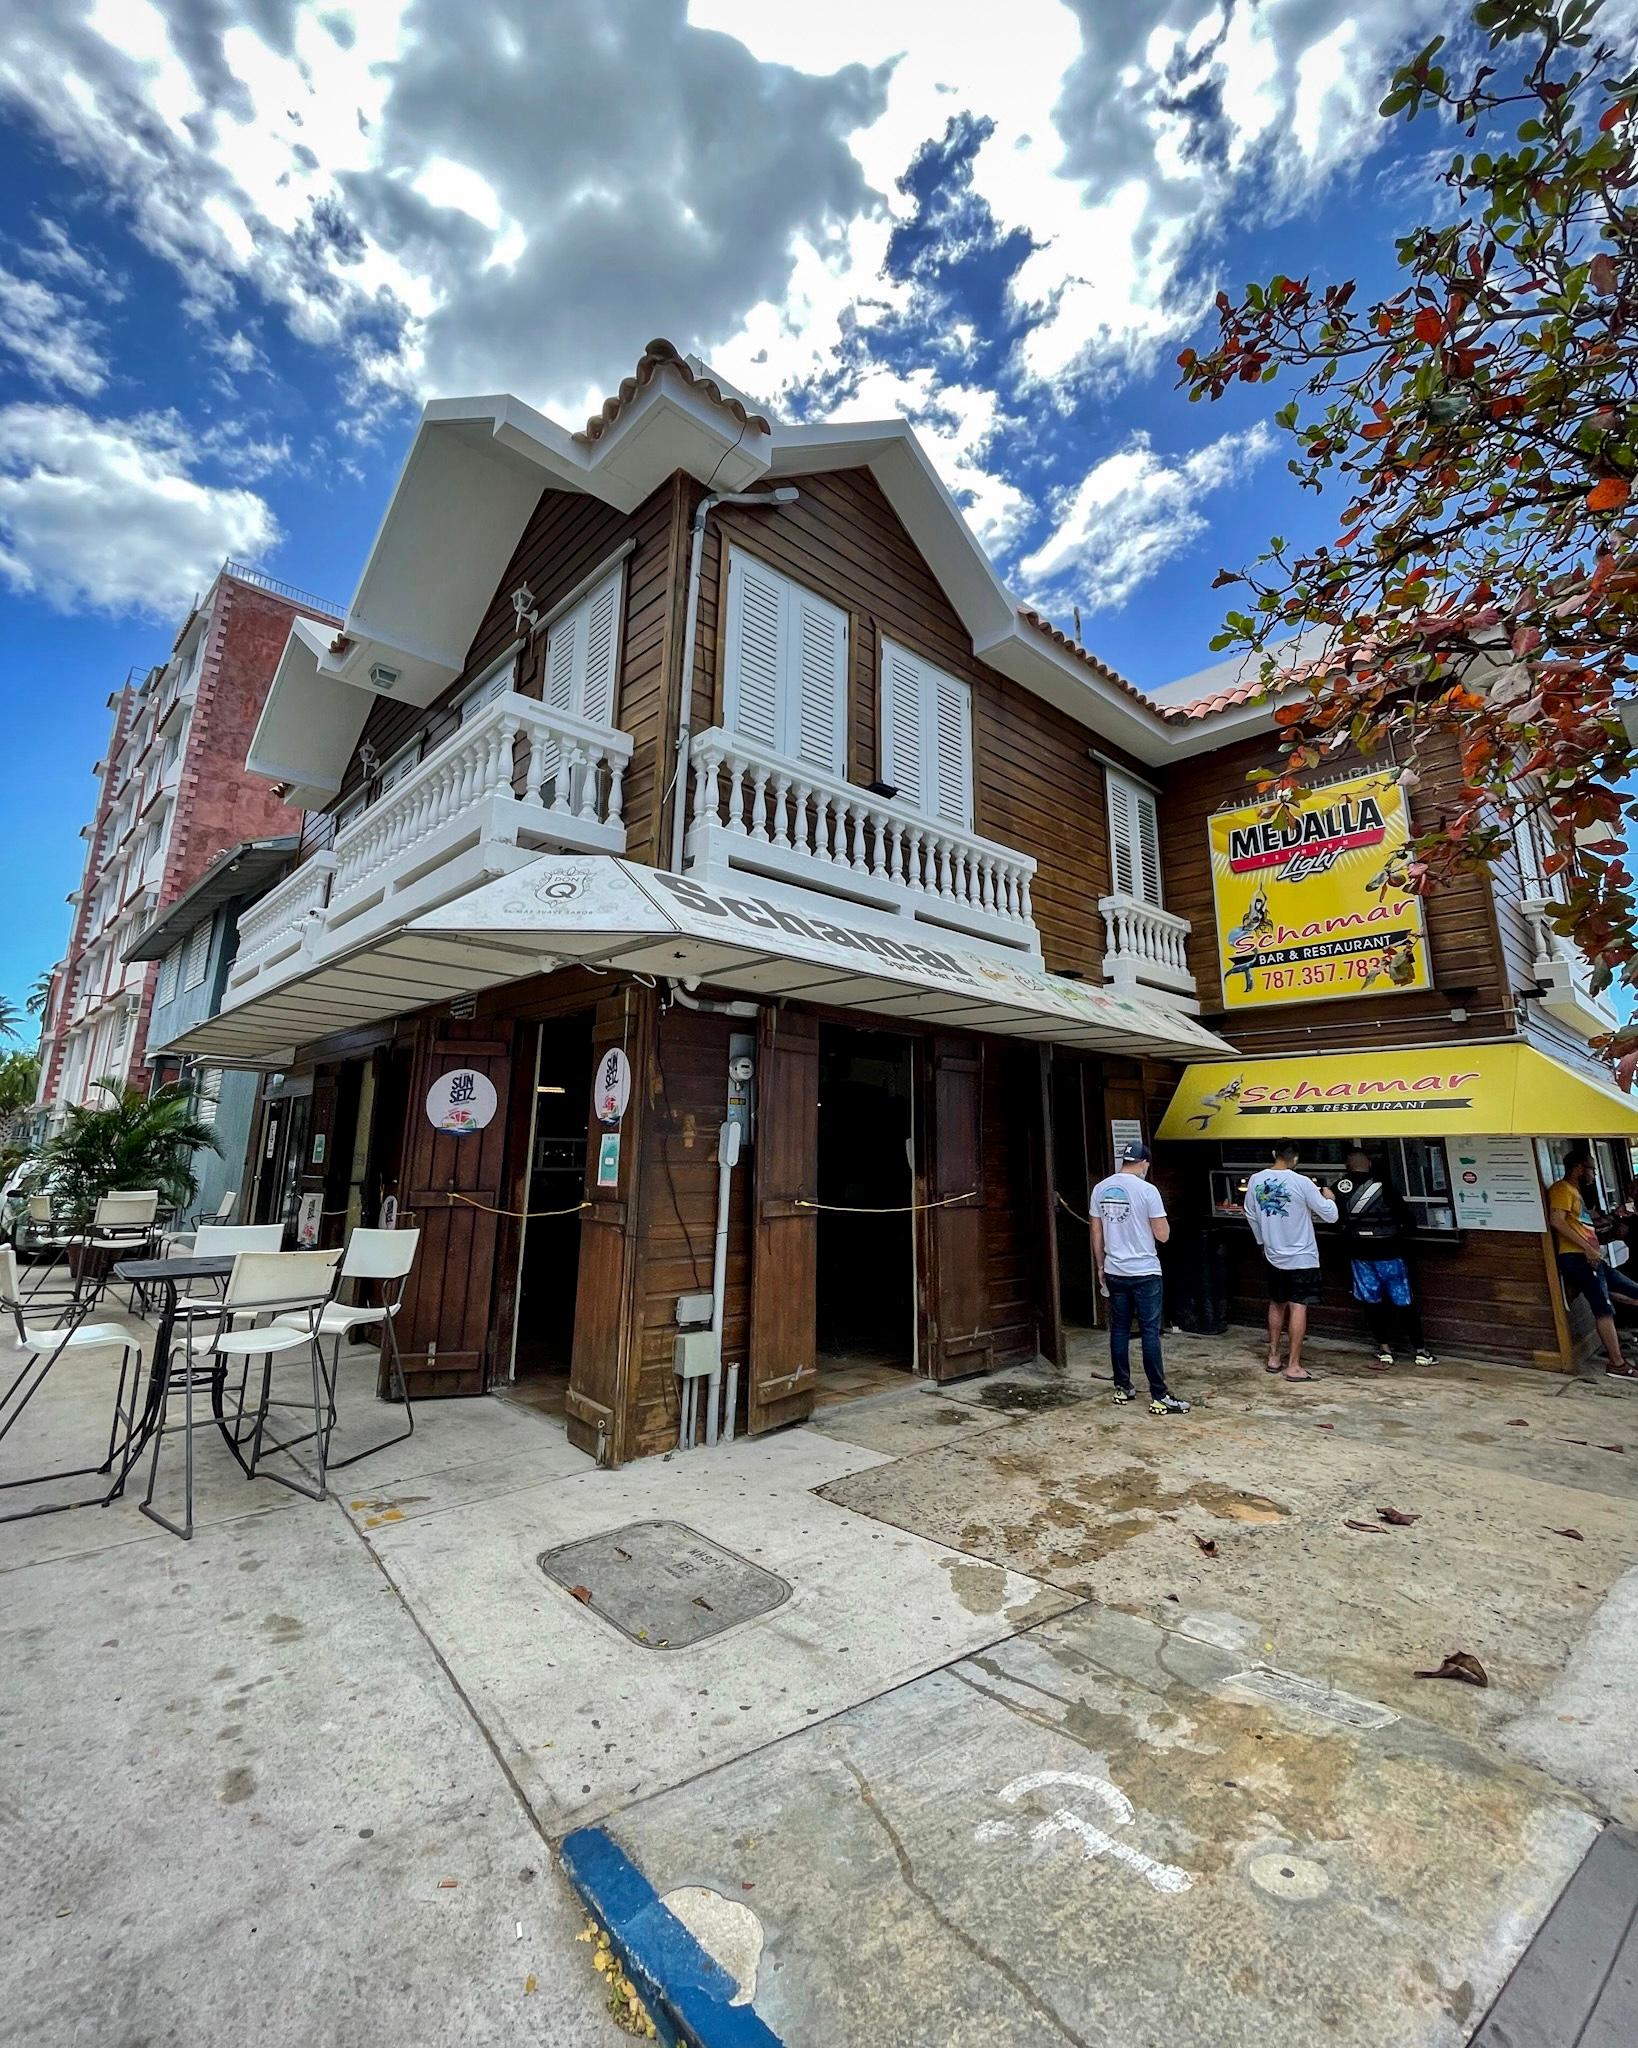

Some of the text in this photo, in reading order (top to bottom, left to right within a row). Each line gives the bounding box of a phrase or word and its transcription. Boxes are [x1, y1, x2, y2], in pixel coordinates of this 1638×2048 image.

[1230, 796, 1386, 861] MEDALLA
[1276, 846, 1346, 882] Light
[545, 882, 577, 899] Q
[653, 873, 973, 977] Schamar
[1259, 934, 1392, 966] BAR & RESTAURANT
[452, 1074, 474, 1090] SUN
[1269, 1100, 1427, 1114] BAR & RESTAURANT
